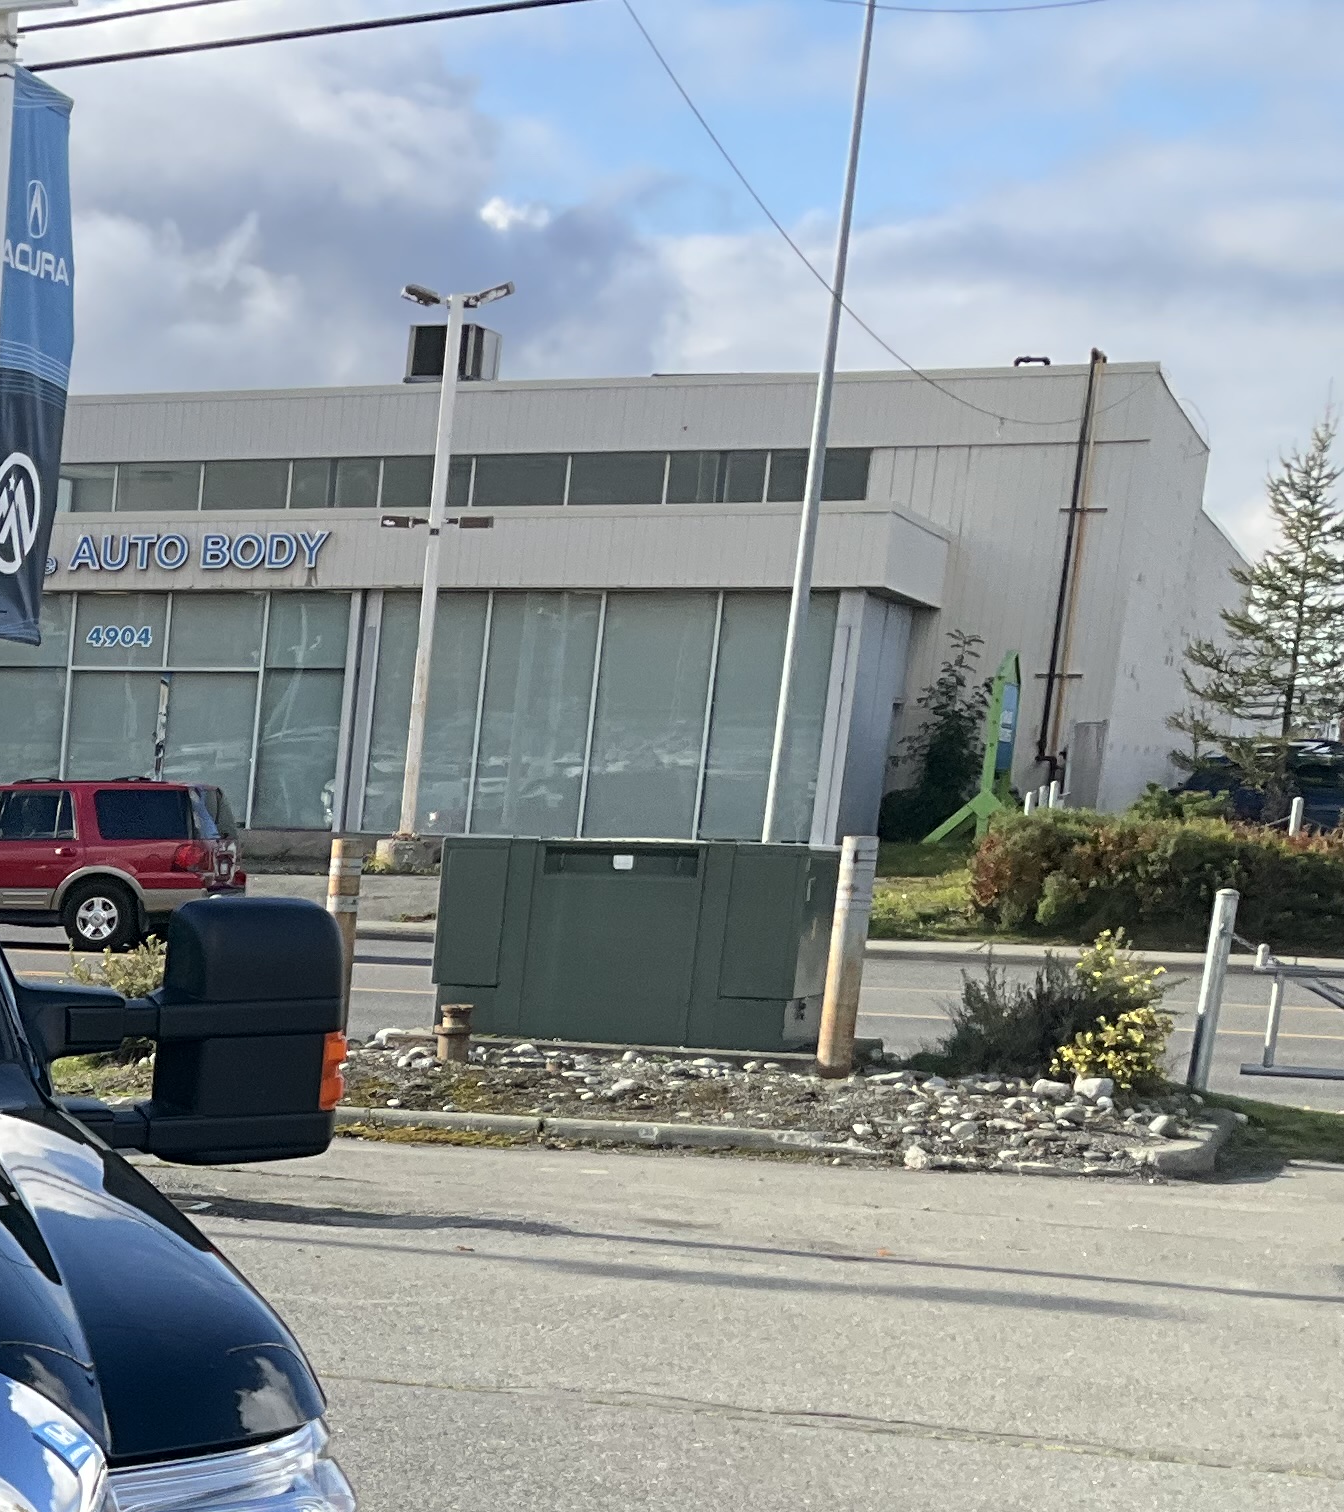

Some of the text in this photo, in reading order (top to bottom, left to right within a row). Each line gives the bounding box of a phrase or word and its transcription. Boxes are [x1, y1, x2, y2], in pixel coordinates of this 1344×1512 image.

[3, 239, 69, 286] ACURA
[68, 533, 188, 571] AUTO
[200, 531, 332, 570] BODY
[86, 626, 153, 648] 4904
